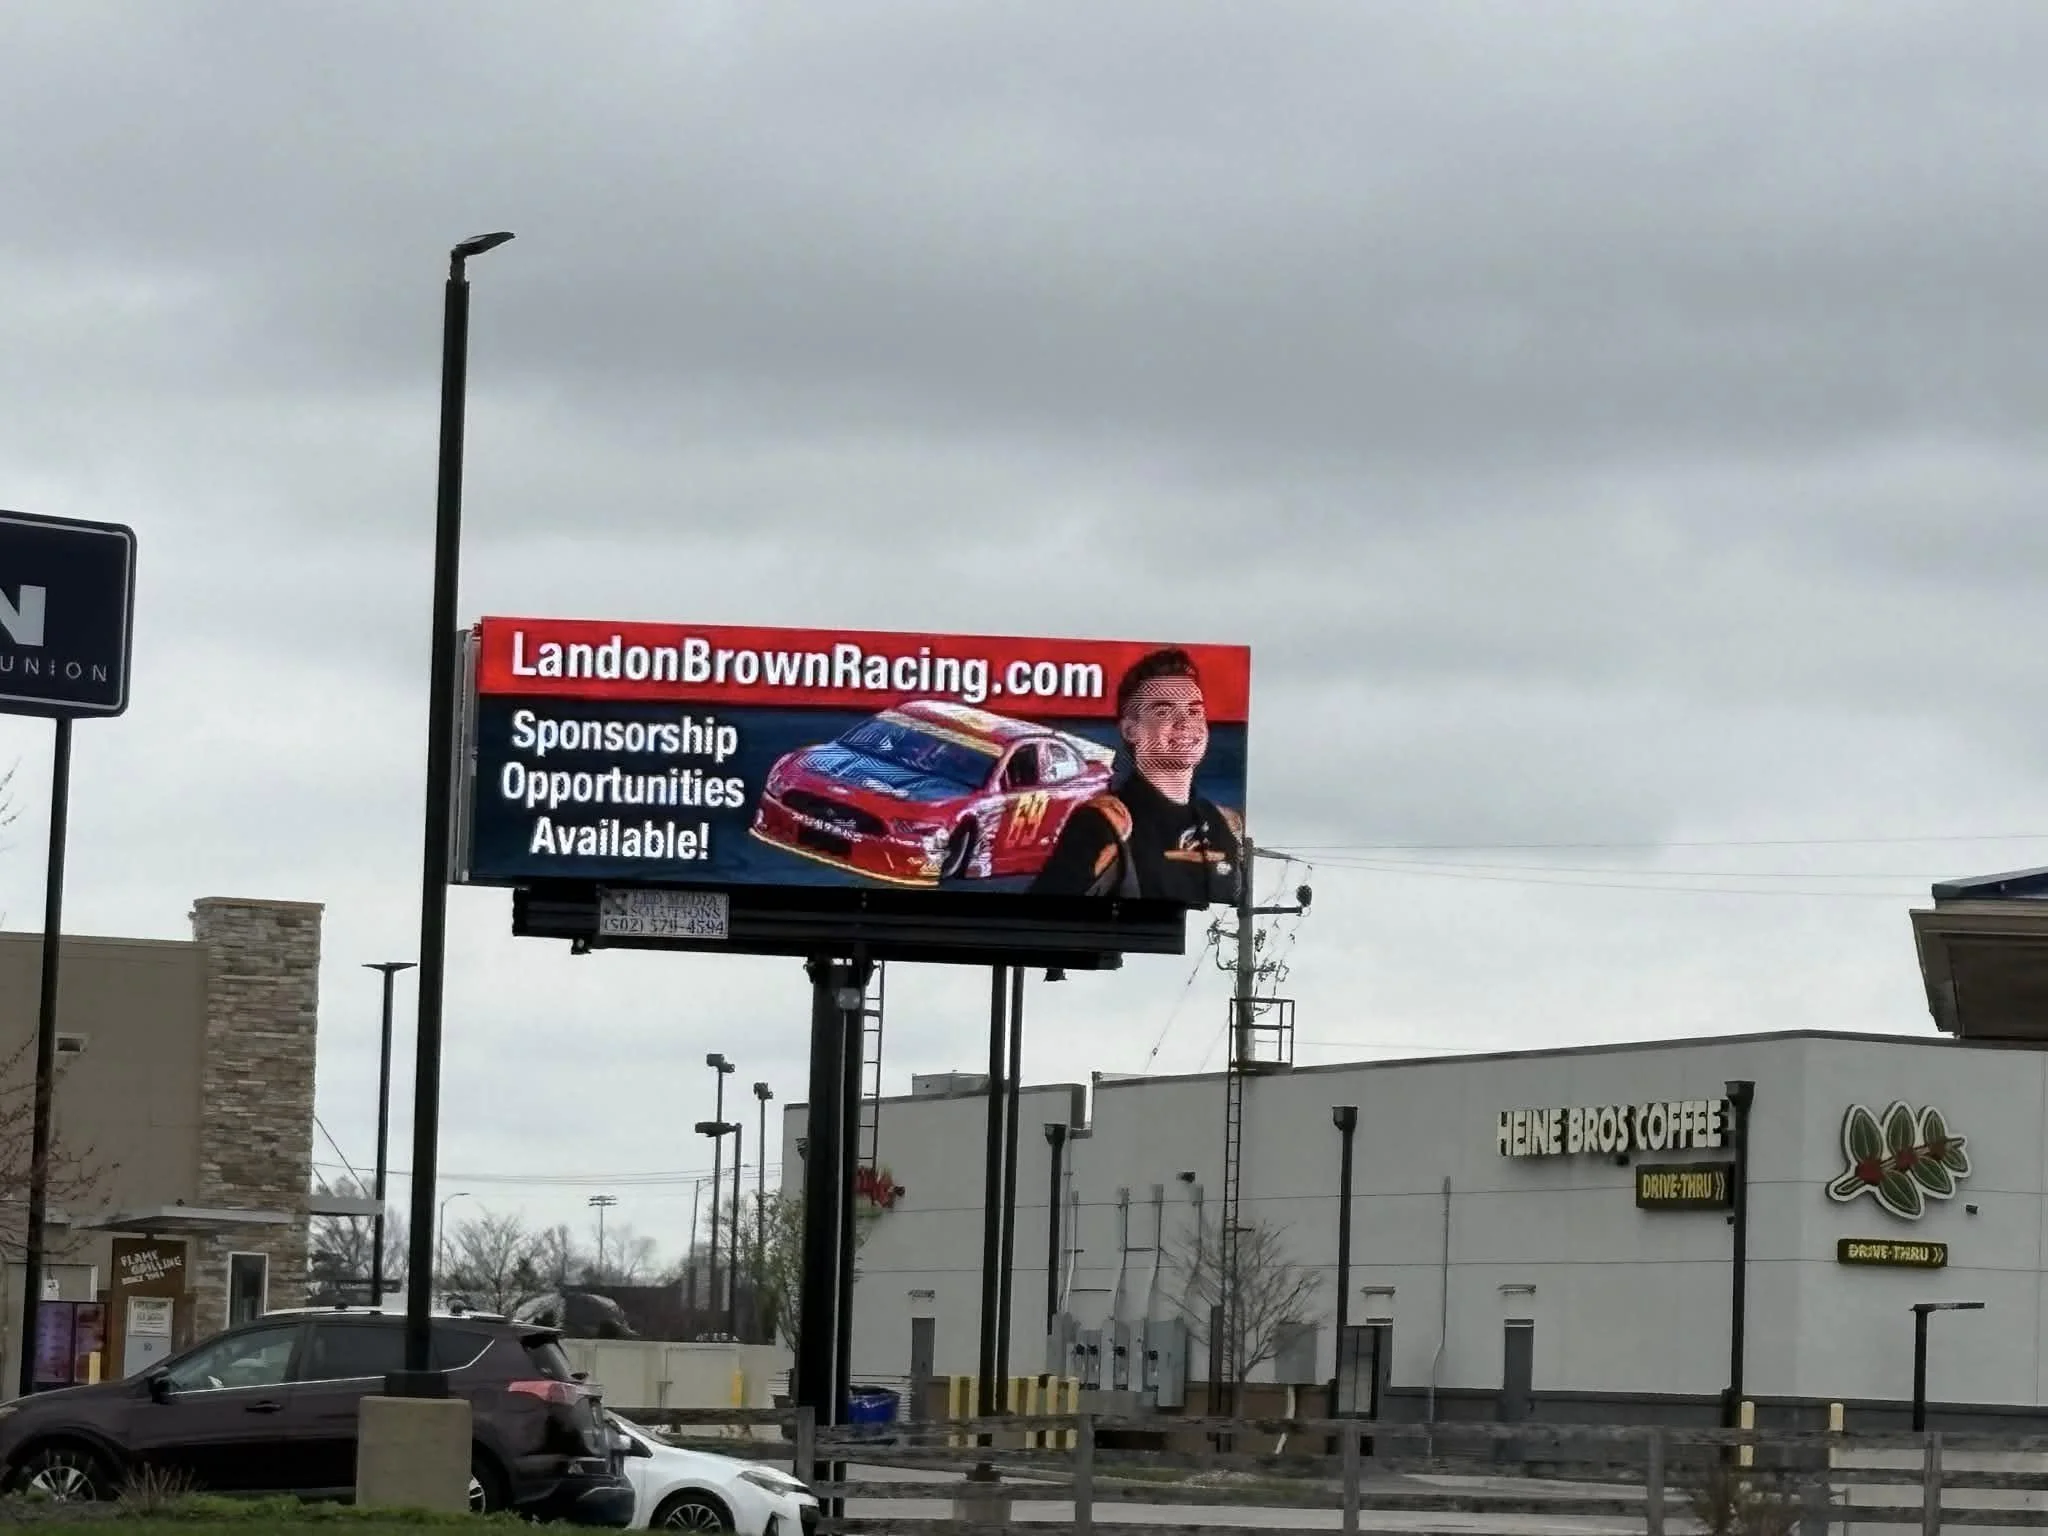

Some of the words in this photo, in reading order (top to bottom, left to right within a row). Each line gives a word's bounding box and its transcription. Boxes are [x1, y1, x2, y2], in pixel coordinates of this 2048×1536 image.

[0, 655, 107, 682] UNION
[511, 630, 1103, 702] LandonBrownRacing.com
[512, 709, 738, 762] Sponsorship
[502, 761, 745, 809] Opportunities
[530, 816, 710, 860] Available!
[604, 918, 643, 934] (502)
[631, 905, 721, 920] SOLUTIONS
[1498, 1108, 1563, 1156] HEINE
[1634, 1099, 1722, 1150] COFFEE
